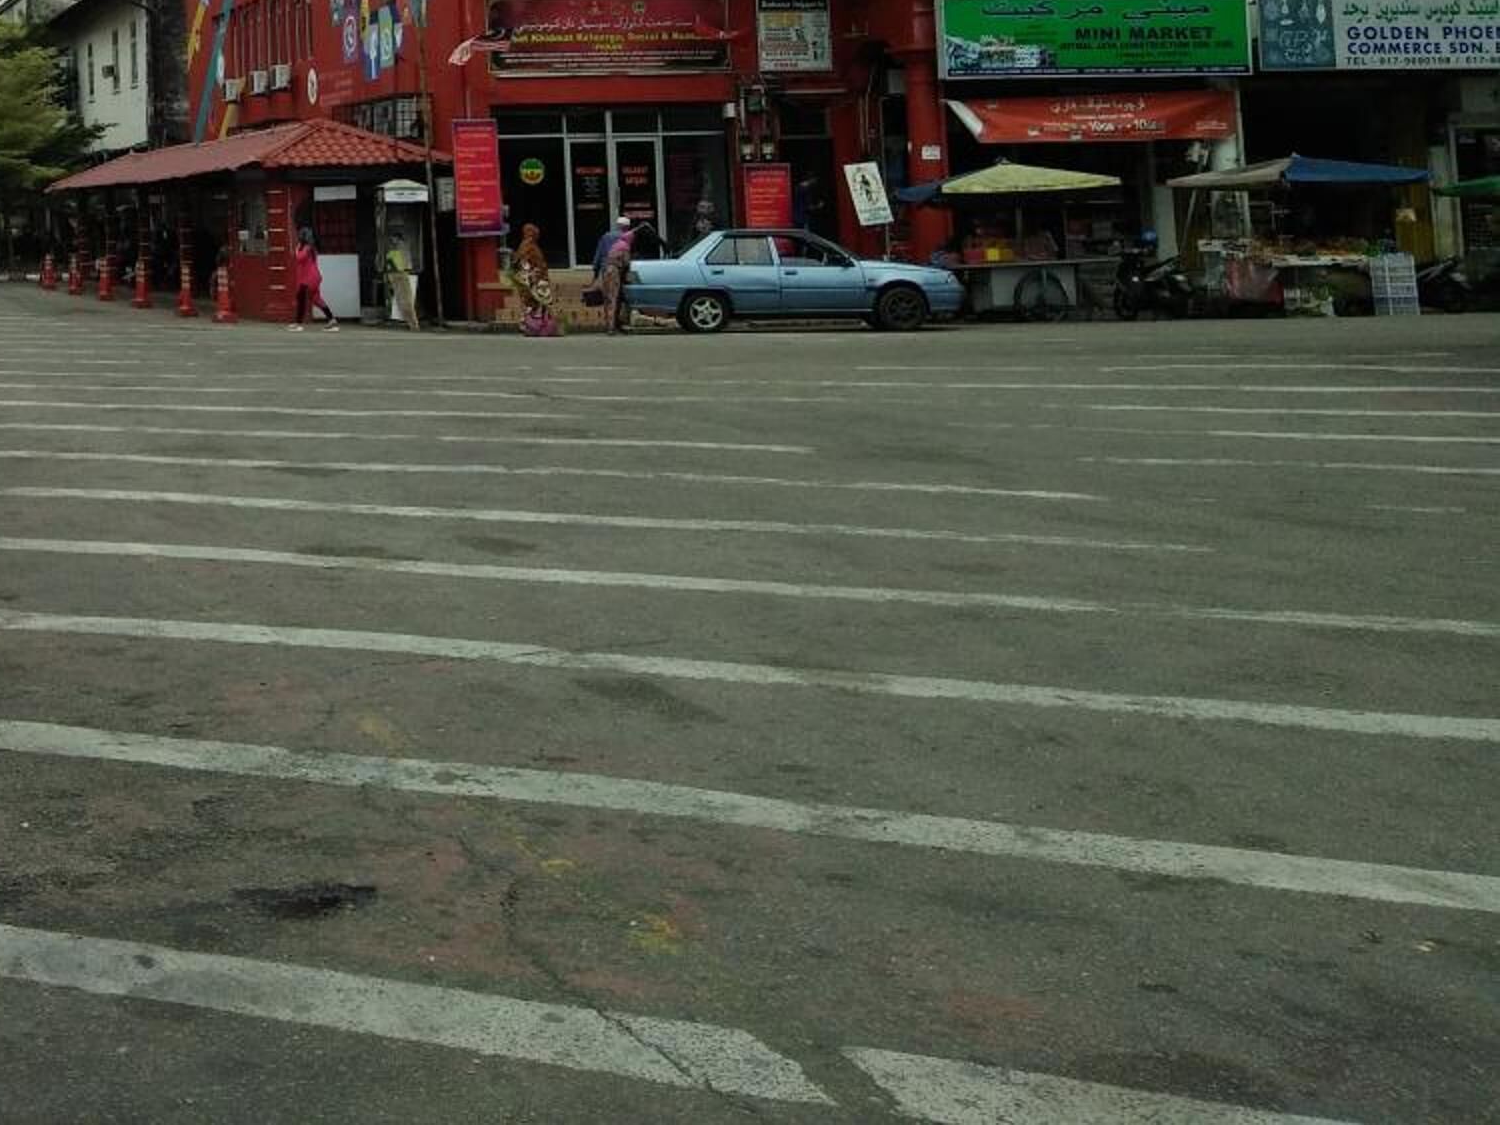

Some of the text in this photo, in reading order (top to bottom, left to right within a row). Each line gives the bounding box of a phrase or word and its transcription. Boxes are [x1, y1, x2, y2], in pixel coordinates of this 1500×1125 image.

[1075, 26, 1216, 41] MINI MARKET
[1347, 26, 1500, 40] GOLDEN PHOE
[1347, 42, 1490, 55] COMMERCE SDN.
